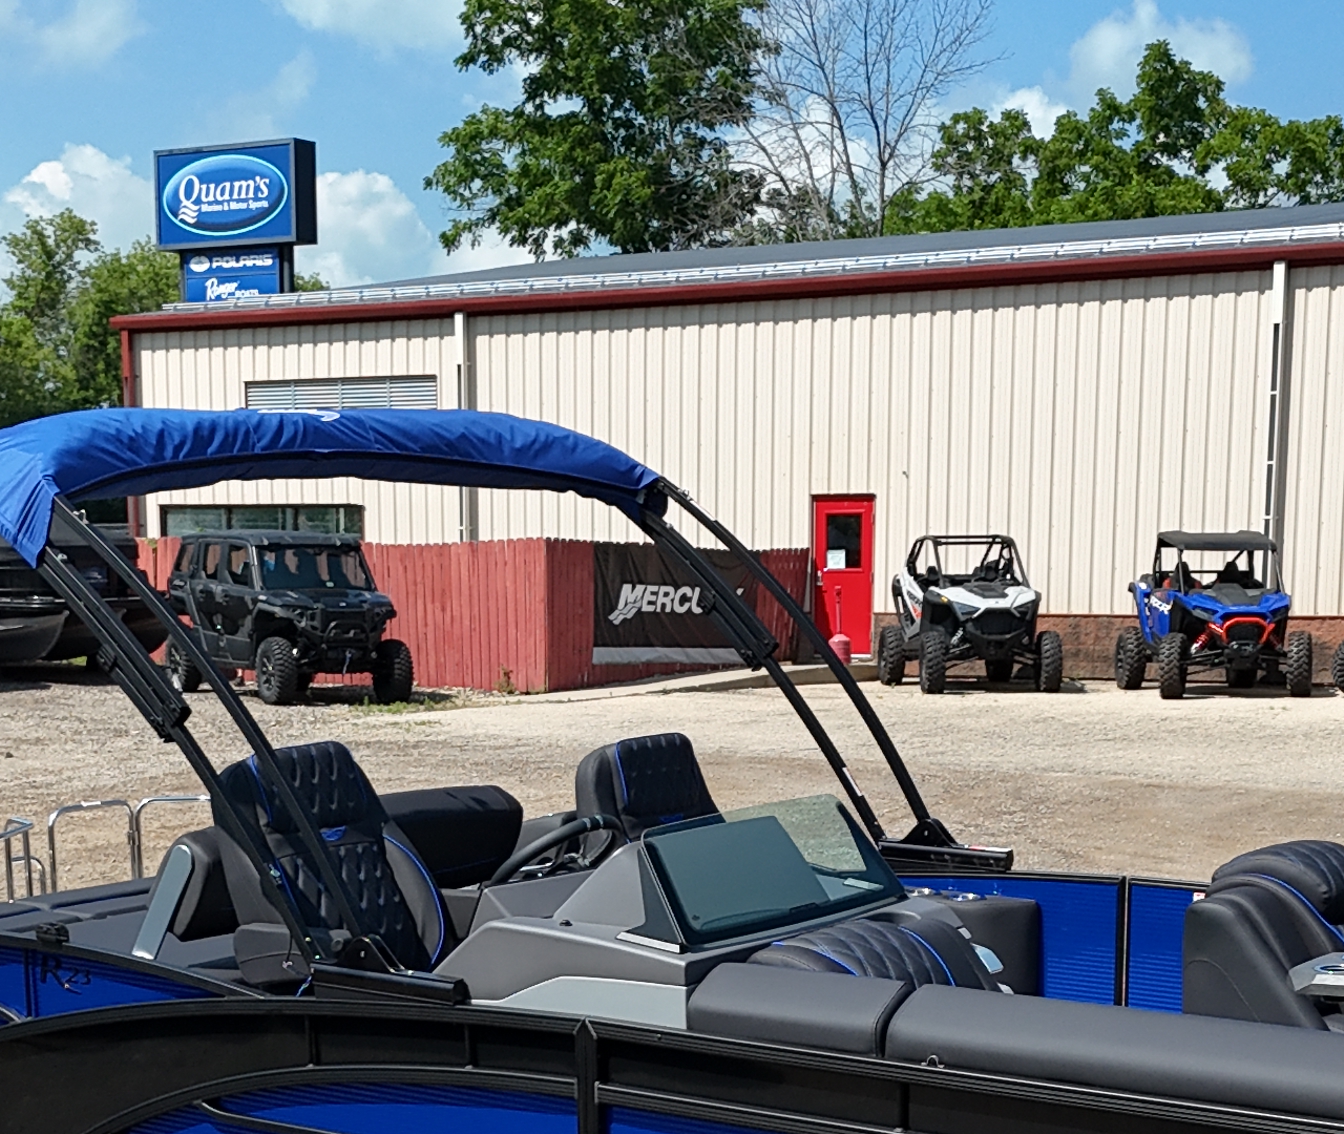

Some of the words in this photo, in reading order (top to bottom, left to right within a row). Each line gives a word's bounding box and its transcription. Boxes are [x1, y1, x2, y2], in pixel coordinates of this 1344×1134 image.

[178, 175, 270, 209] Quam's
[200, 203, 223, 212] Marine
[223, 202, 229, 211] &
[229, 201, 248, 210] Motor
[248, 199, 269, 210] Sports
[211, 253, 274, 269] POLARIS
[204, 277, 239, 301] Ranger
